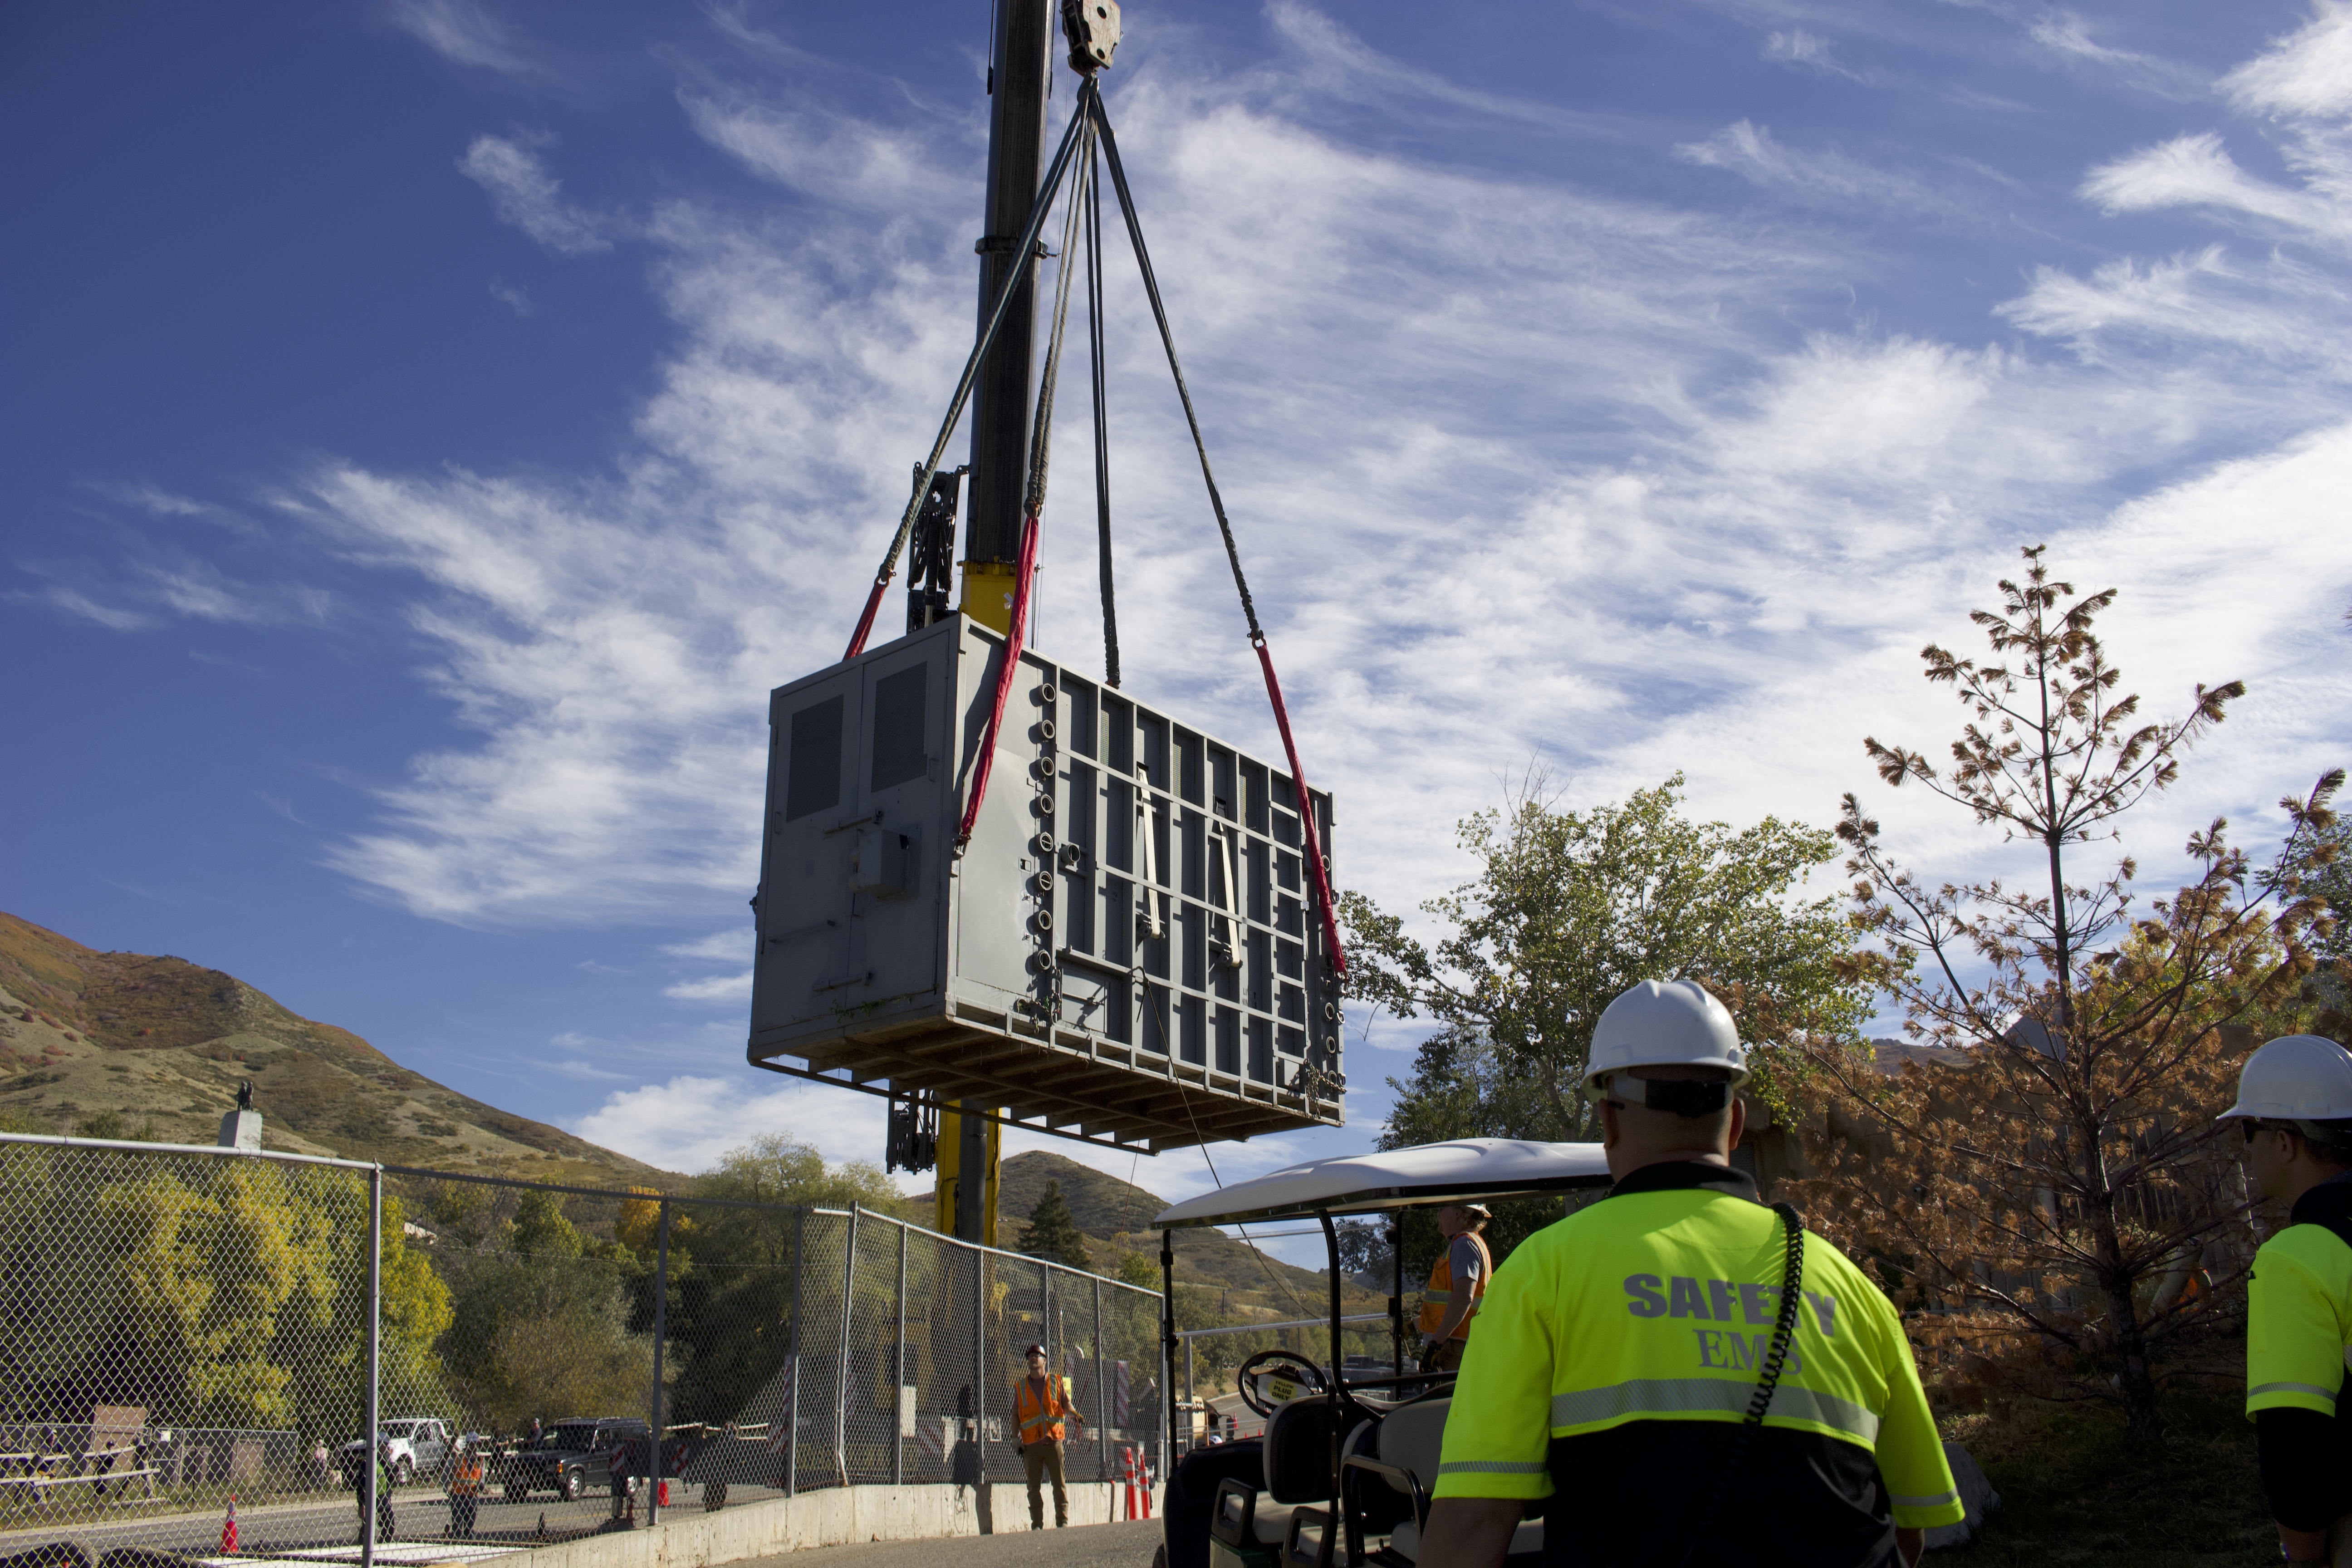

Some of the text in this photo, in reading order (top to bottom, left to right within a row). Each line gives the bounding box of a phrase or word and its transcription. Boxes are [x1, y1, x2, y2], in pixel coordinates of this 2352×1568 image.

[1692, 1328, 1802, 1375] EMS
[1276, 1381, 1294, 1389] YELLOW
[1274, 1385, 1292, 1395] PLUG
[1272, 1392, 1289, 1401] ONLY
